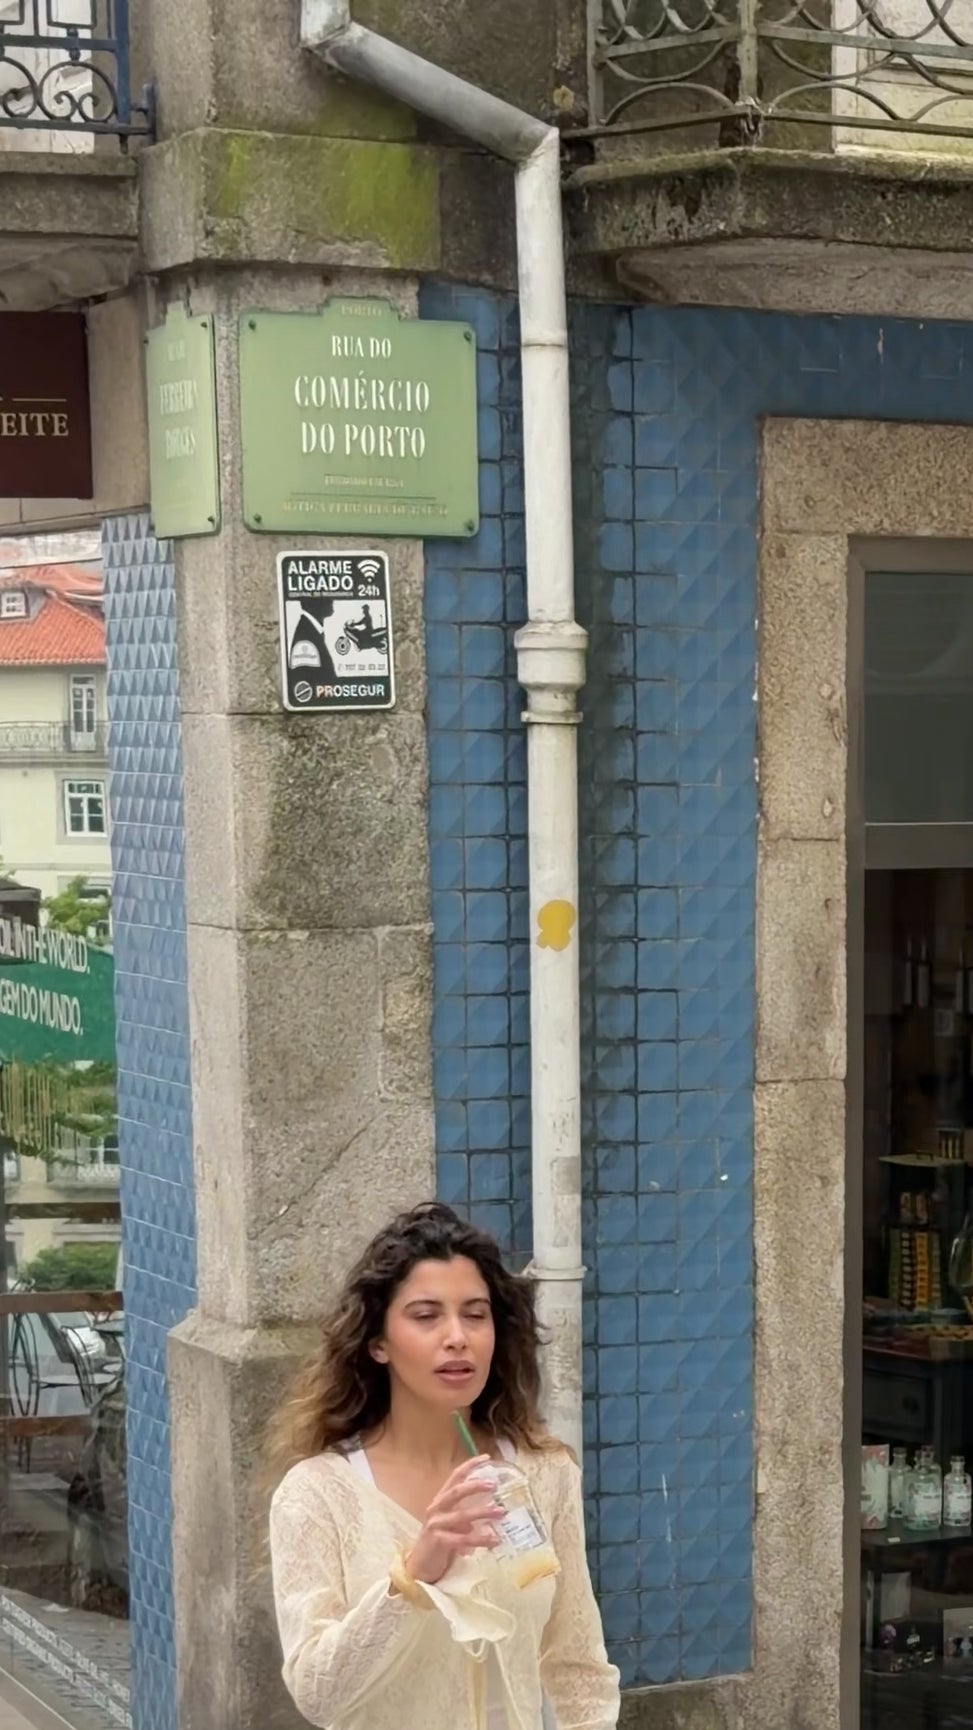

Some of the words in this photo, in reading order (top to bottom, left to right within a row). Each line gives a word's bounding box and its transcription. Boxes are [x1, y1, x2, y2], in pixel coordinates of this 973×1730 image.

[332, 335, 365, 357] RUA
[370, 337, 392, 359] DO
[294, 370, 430, 413] COMÉRCIO
[0, 412, 70, 437] EITE
[302, 421, 336, 454] DO
[345, 424, 426, 458] PORTO
[287, 560, 353, 574] ALARME
[287, 575, 354, 591] LIGADO
[358, 584, 380, 596] 24h
[316, 684, 385, 698] PROSEGUR
[47, 928, 91, 974] WORLD.
[21, 982, 39, 1022] DO
[39, 988, 83, 1036] MUNDO.
